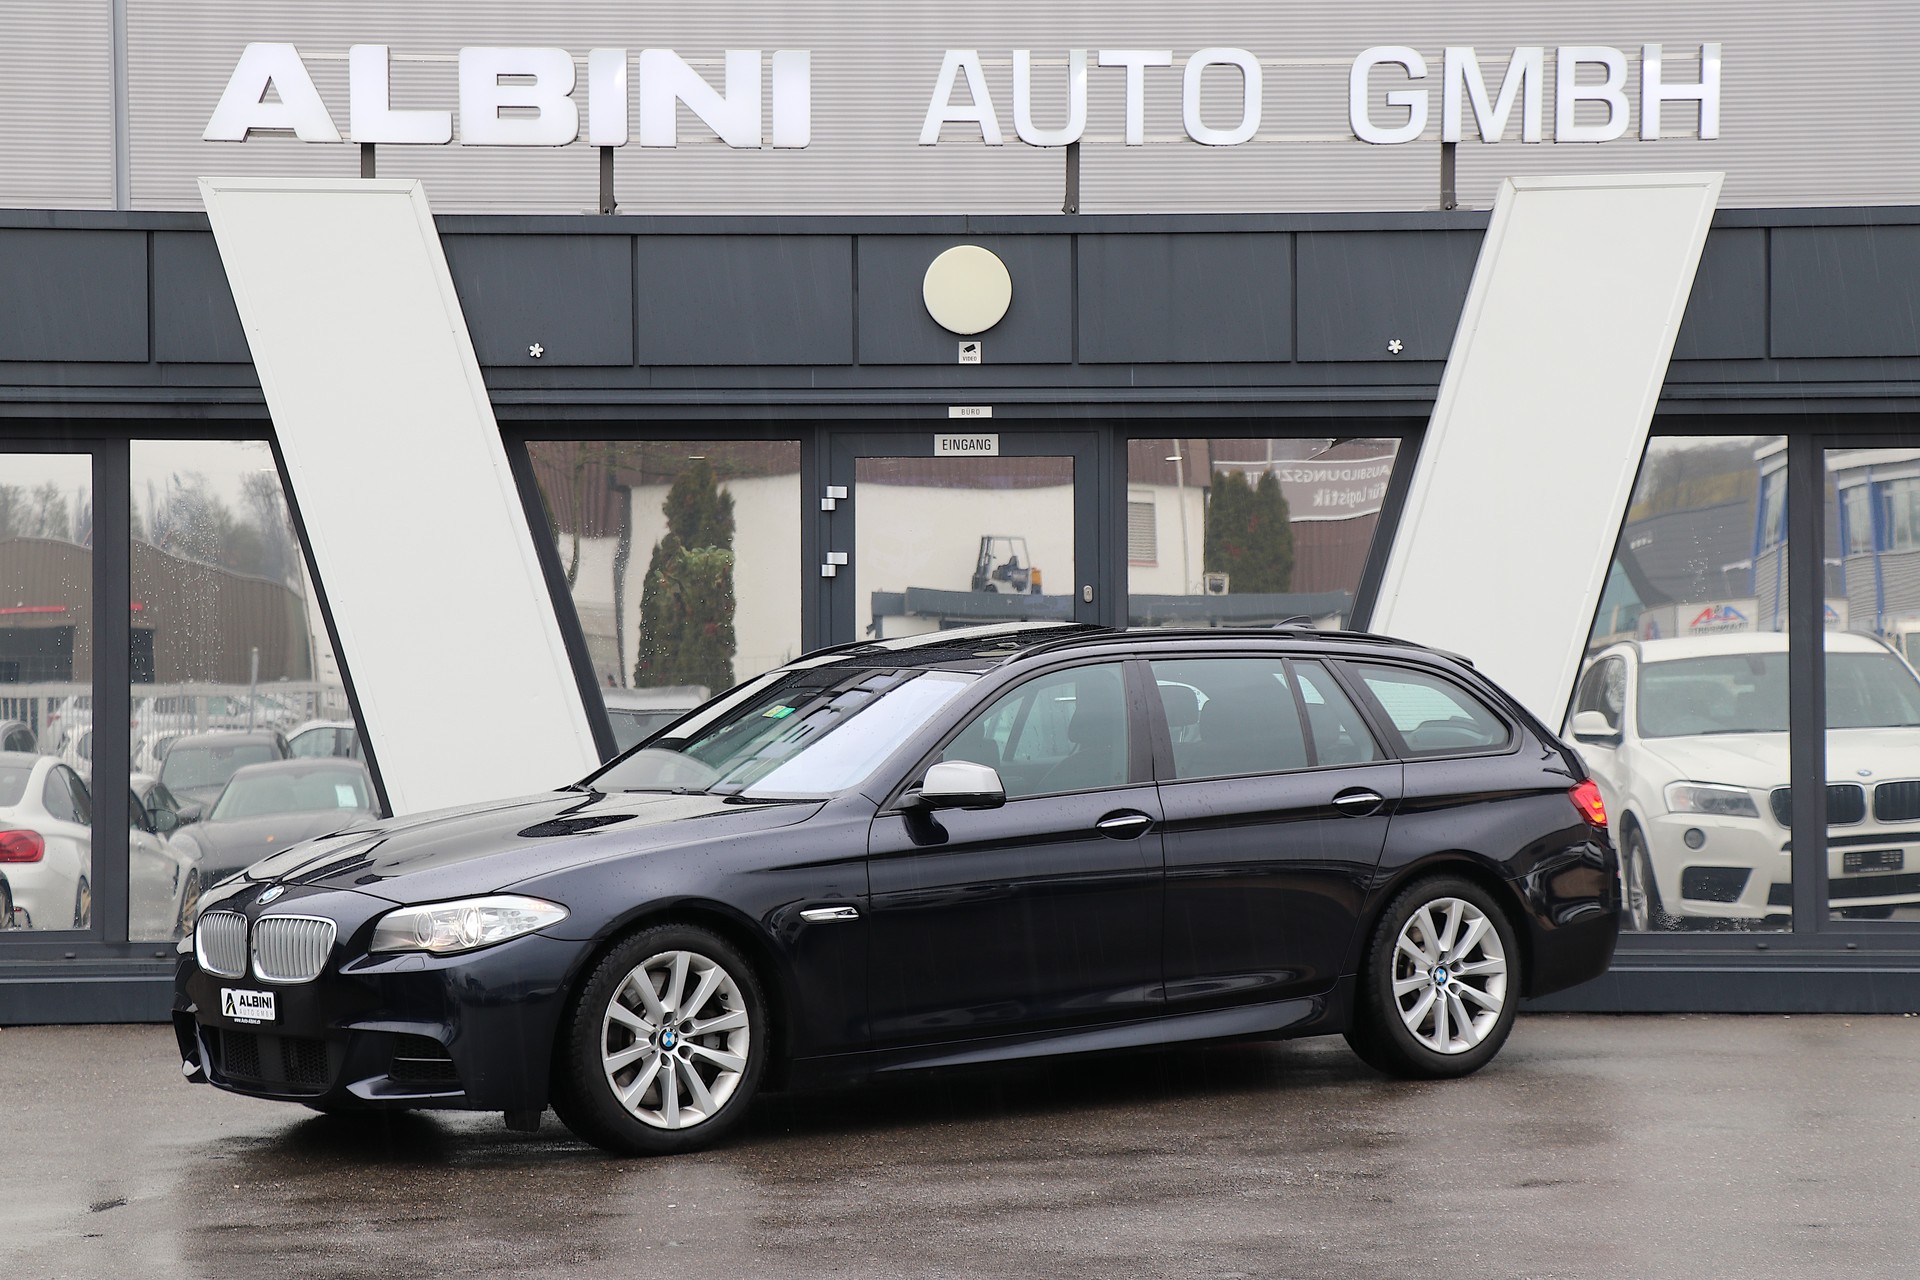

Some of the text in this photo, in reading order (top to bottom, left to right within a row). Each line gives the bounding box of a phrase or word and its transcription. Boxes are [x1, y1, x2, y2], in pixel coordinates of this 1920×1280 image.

[202, 41, 1722, 149] ALBINI AUTO GMBH
[942, 439, 991, 451] EINGANG
[239, 995, 272, 1008] ALBINI
